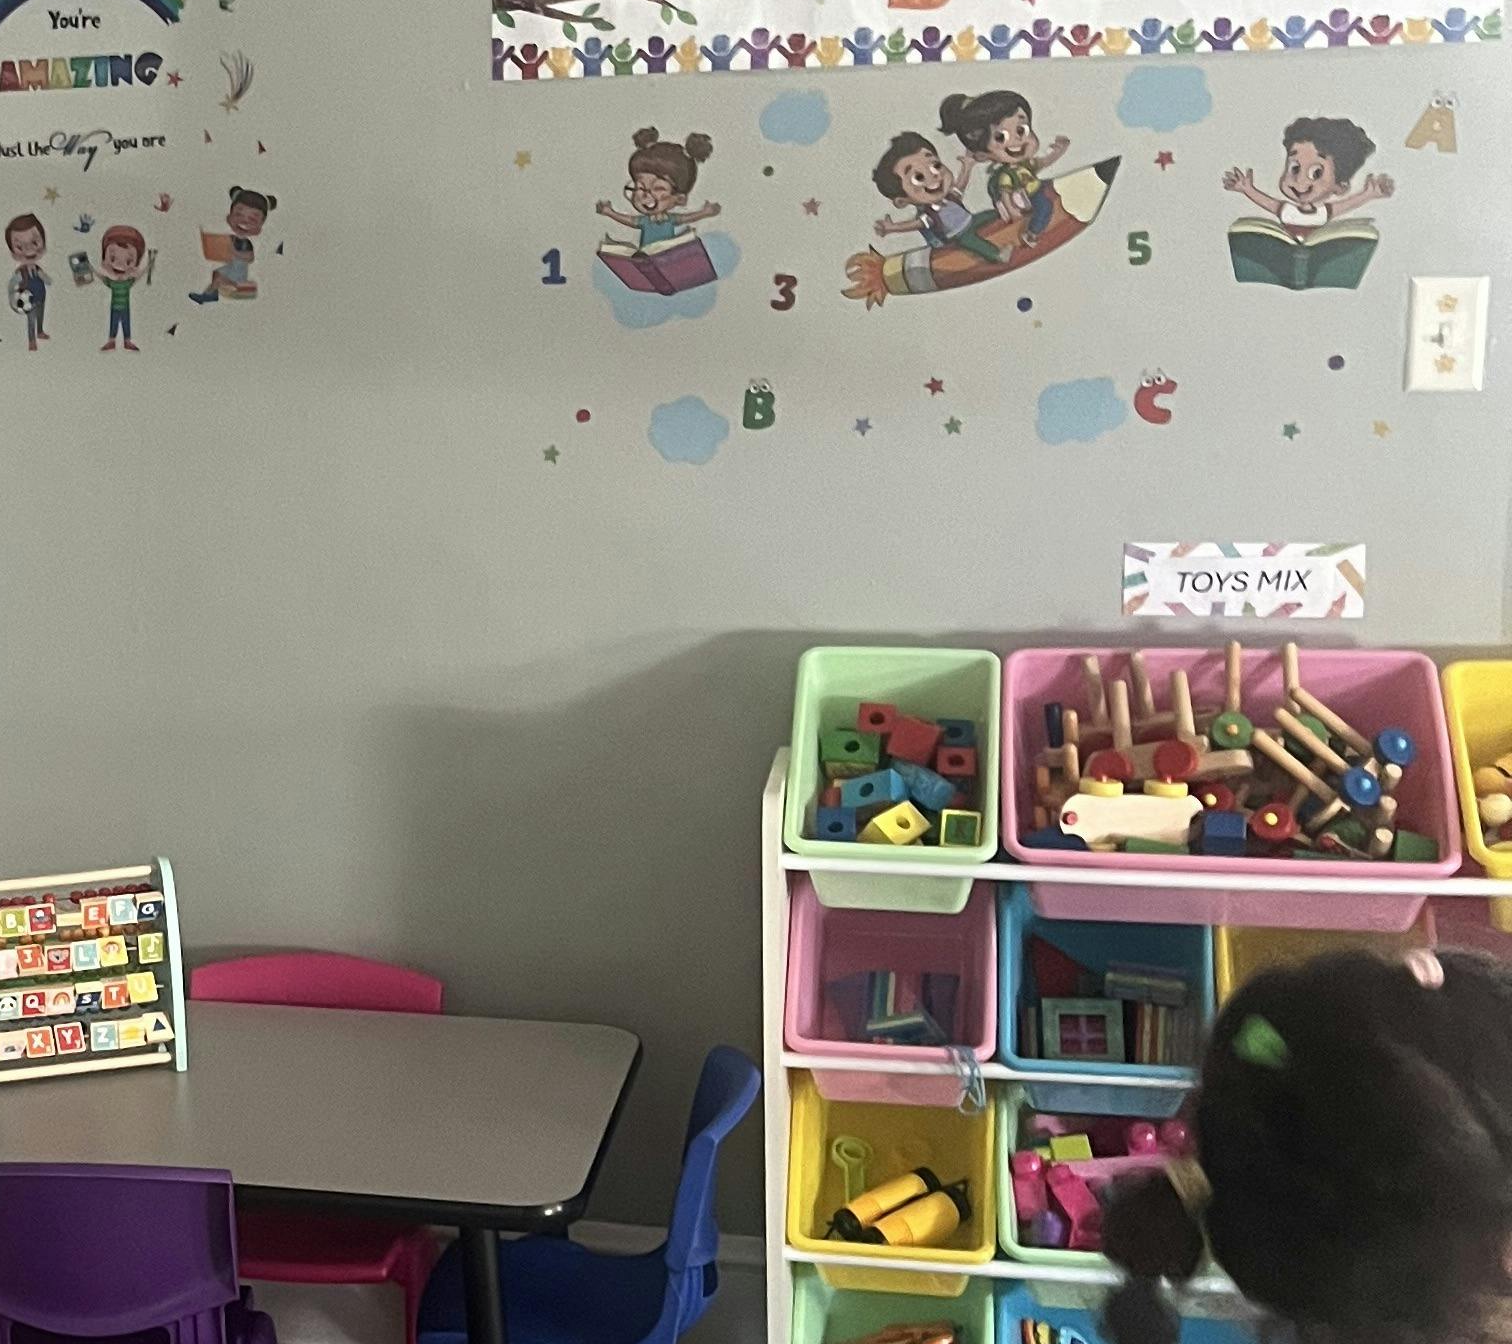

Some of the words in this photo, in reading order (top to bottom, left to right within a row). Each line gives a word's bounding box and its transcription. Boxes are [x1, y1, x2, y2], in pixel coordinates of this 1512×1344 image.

[47, 9, 102, 32] You're
[1404, 101, 1459, 155] A
[28, 141, 50, 157] the
[113, 137, 138, 155] you
[142, 135, 166, 148] are
[1126, 232, 1153, 266] 5
[540, 248, 568, 285] 1
[770, 273, 798, 311] 3
[743, 385, 777, 431] B
[1134, 375, 1178, 425] C
[1176, 570, 1250, 595] TOYS
[1256, 568, 1311, 594] MIX
[78, 946, 90, 962] L
[26, 995, 40, 1009] Q
[108, 987, 120, 1001] T
[31, 1033, 45, 1048] X
[61, 1029, 73, 1044] Y
[97, 1027, 108, 1043] Z
